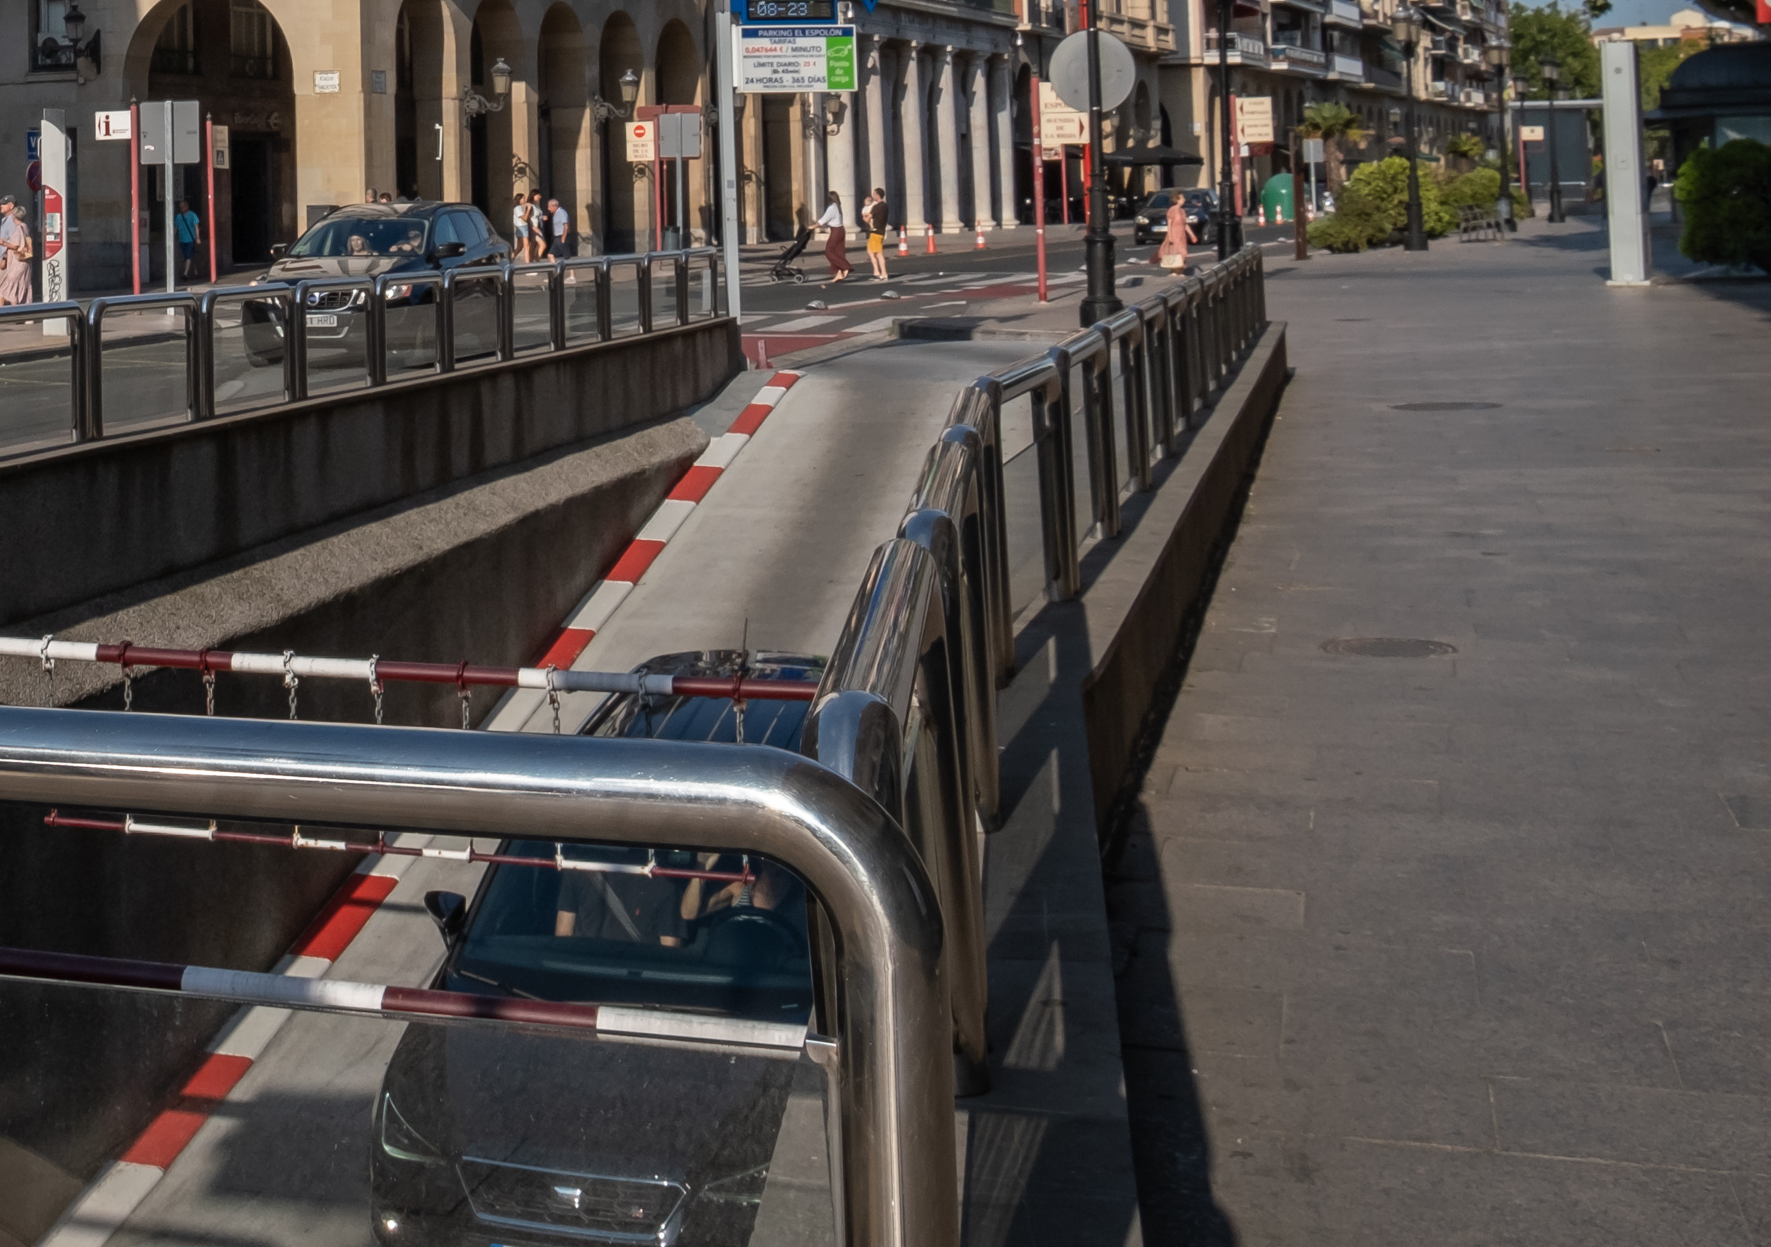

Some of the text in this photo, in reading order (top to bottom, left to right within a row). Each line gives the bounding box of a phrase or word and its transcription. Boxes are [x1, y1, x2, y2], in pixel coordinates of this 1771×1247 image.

[758, 28, 843, 37] PARKING EL ESPOLÓN
[791, 45, 822, 53] MINUTO
[745, 77, 755, 85] 24
[791, 76, 805, 84] 365
[808, 75, 827, 83] DÍAS
